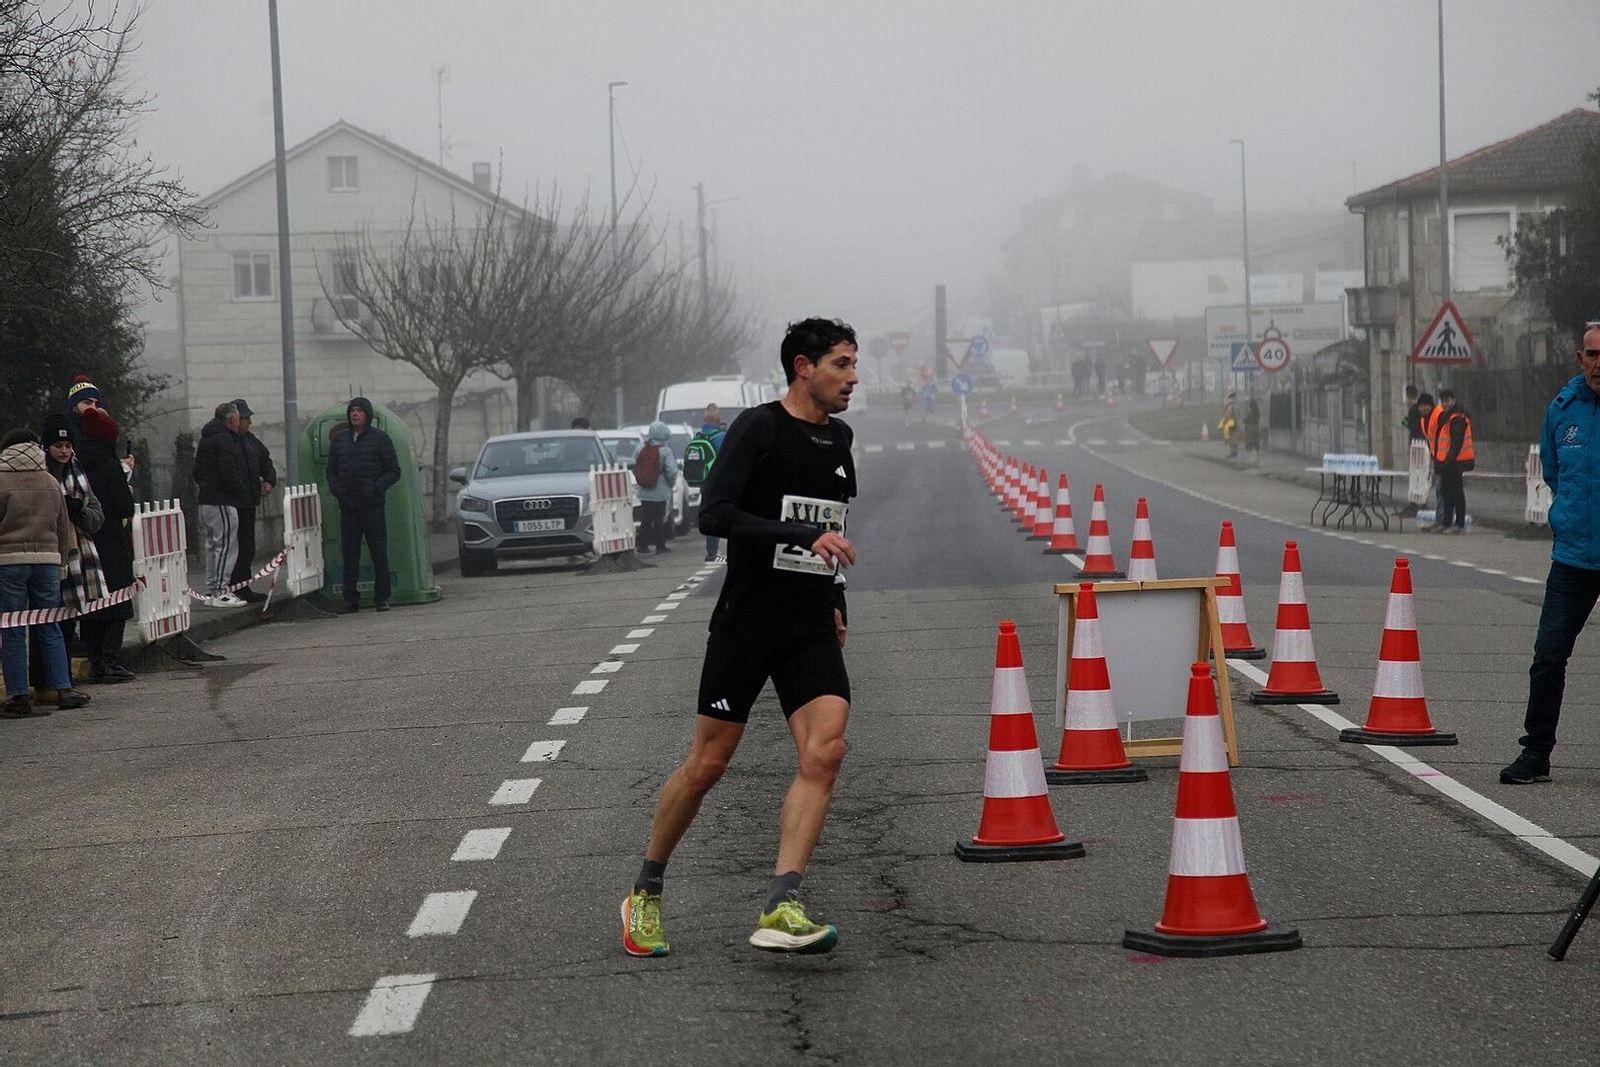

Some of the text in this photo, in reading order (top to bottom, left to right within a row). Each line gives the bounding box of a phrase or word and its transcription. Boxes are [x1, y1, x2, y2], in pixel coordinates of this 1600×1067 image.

[1263, 349, 1284, 361] 40
[522, 520, 561, 531] 1055 LTP
